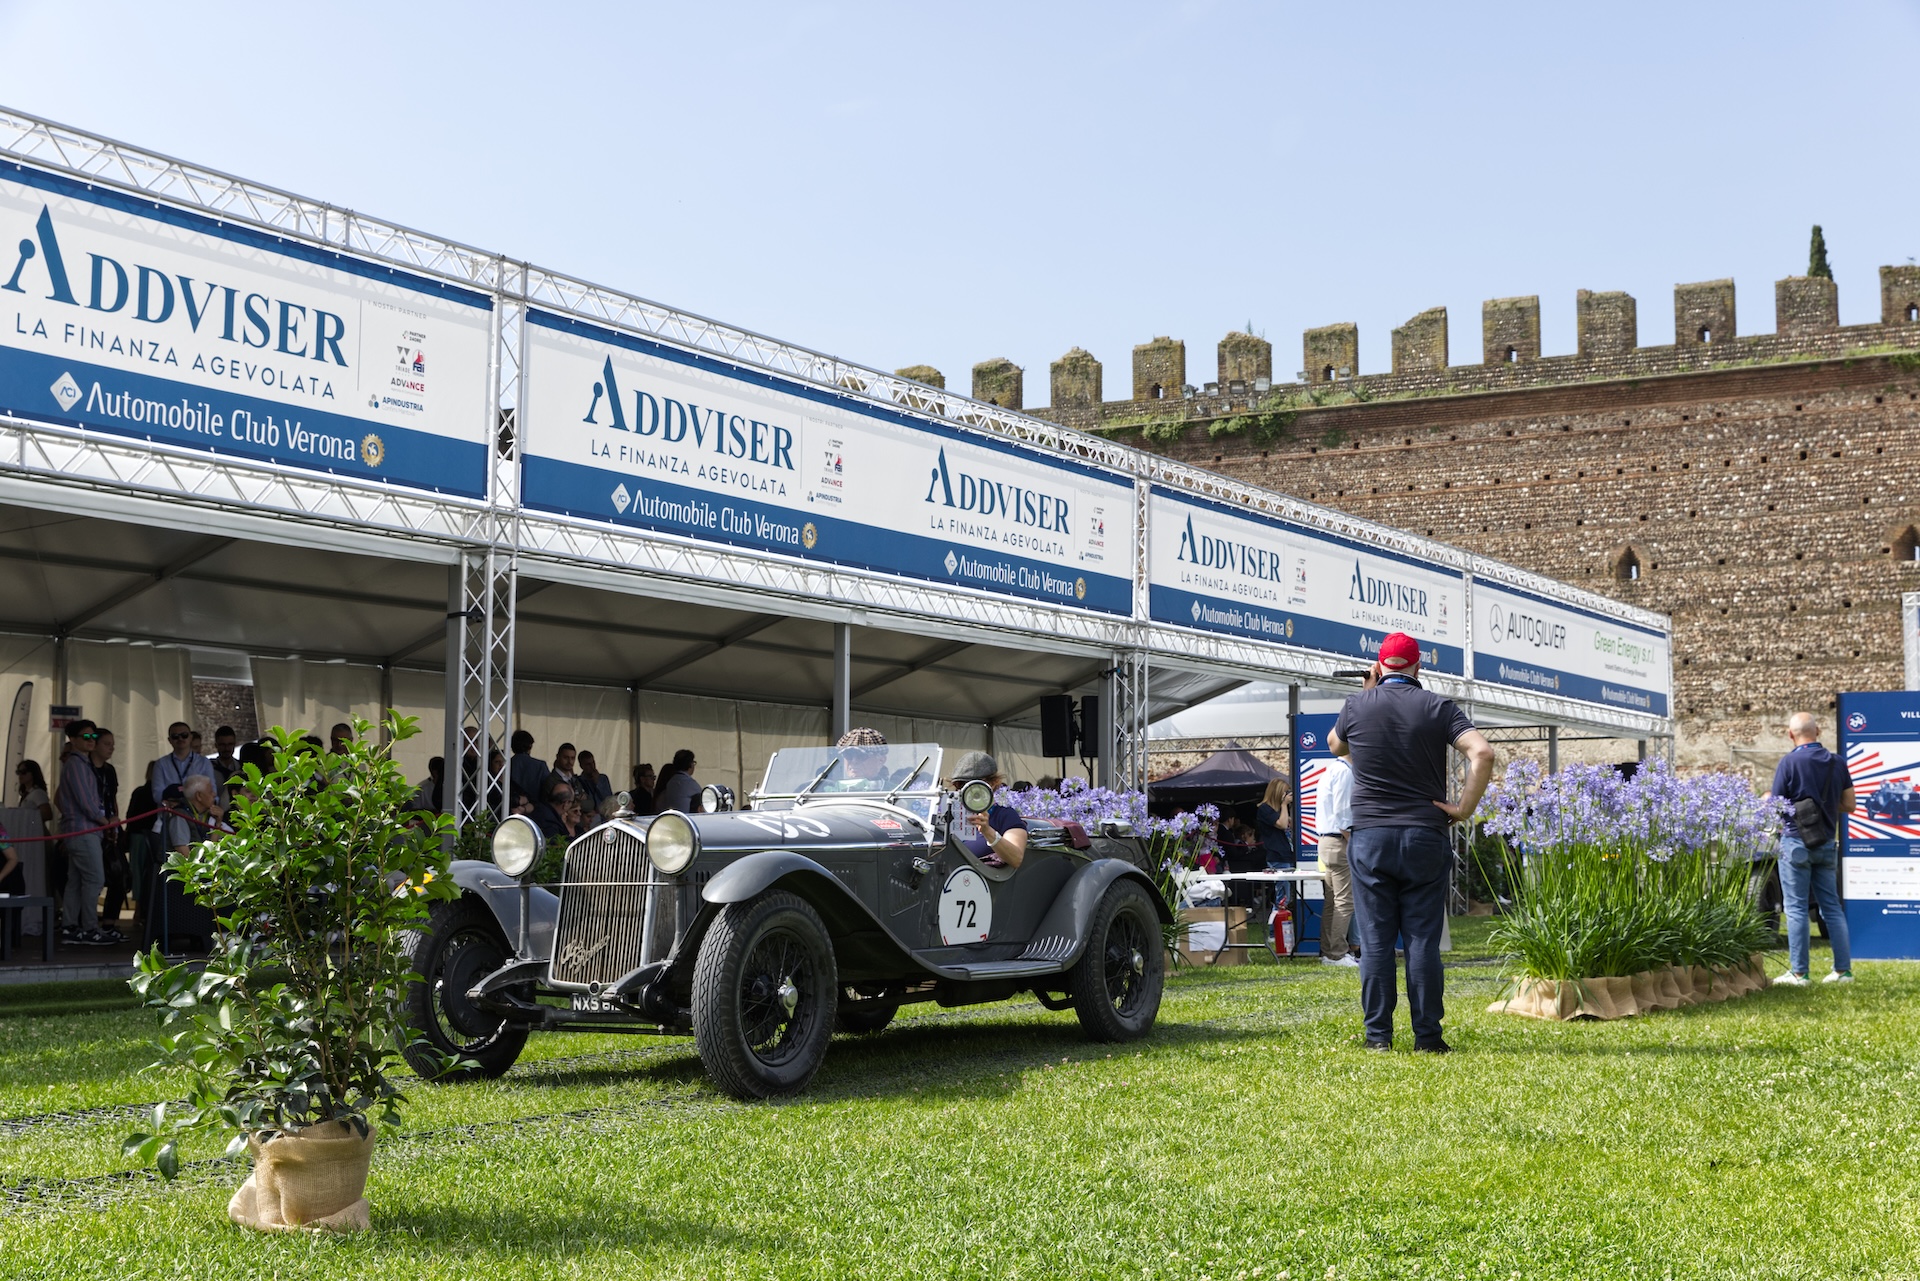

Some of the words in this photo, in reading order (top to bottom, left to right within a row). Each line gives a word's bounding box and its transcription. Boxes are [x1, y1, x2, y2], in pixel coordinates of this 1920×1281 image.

[1, 203, 349, 367] ADDVISER
[372, 301, 397, 312] NOSTRI
[398, 307, 427, 320] PARTNER
[16, 313, 48, 339] LA
[65, 323, 179, 367] FINANZA
[192, 354, 335, 400] AGEVOLATA
[60, 385, 76, 398] ACI
[382, 396, 424, 412] APINDUSTRIA
[583, 354, 795, 471] ADDVISER
[86, 381, 224, 437] Automobile
[230, 409, 280, 447] Club
[284, 419, 356, 461] Verona
[591, 439, 611, 459] LA
[620, 446, 689, 476] FINANZA
[698, 465, 787, 497] AGEVOLATA
[925, 444, 1070, 535] ADDVISER
[632, 489, 716, 529] Automobile
[721, 507, 751, 536] Club
[754, 513, 799, 545] Verona
[931, 515, 944, 531] LA
[950, 519, 997, 542] FINANZA
[1002, 532, 1064, 557] AGEVOLATA
[1177, 512, 1281, 583] ADDVISER
[958, 555, 1016, 585] Automobile
[1018, 567, 1040, 591] Club
[1042, 571, 1073, 597] Verona
[1181, 571, 1191, 583] LA
[1195, 574, 1229, 591] FINANZA
[1232, 584, 1277, 602] AGEVOLATA
[1349, 557, 1428, 617] ADDVISER
[1201, 603, 1243, 628] Automobile
[1244, 612, 1260, 631] Club
[1261, 615, 1285, 635] Verona
[1352, 609, 1359, 619] LA
[1362, 611, 1388, 626] FINANZA
[1391, 618, 1425, 633] AGEVOLATA
[1507, 612, 1566, 650] AUTOSILVER
[1594, 631, 1615, 654] Green
[1618, 637, 1640, 664] Energy
[1505, 665, 1530, 683] Automobile
[1530, 670, 1540, 685] Club
[1540, 672, 1554, 688] Verona
[956, 900, 976, 928] 72
